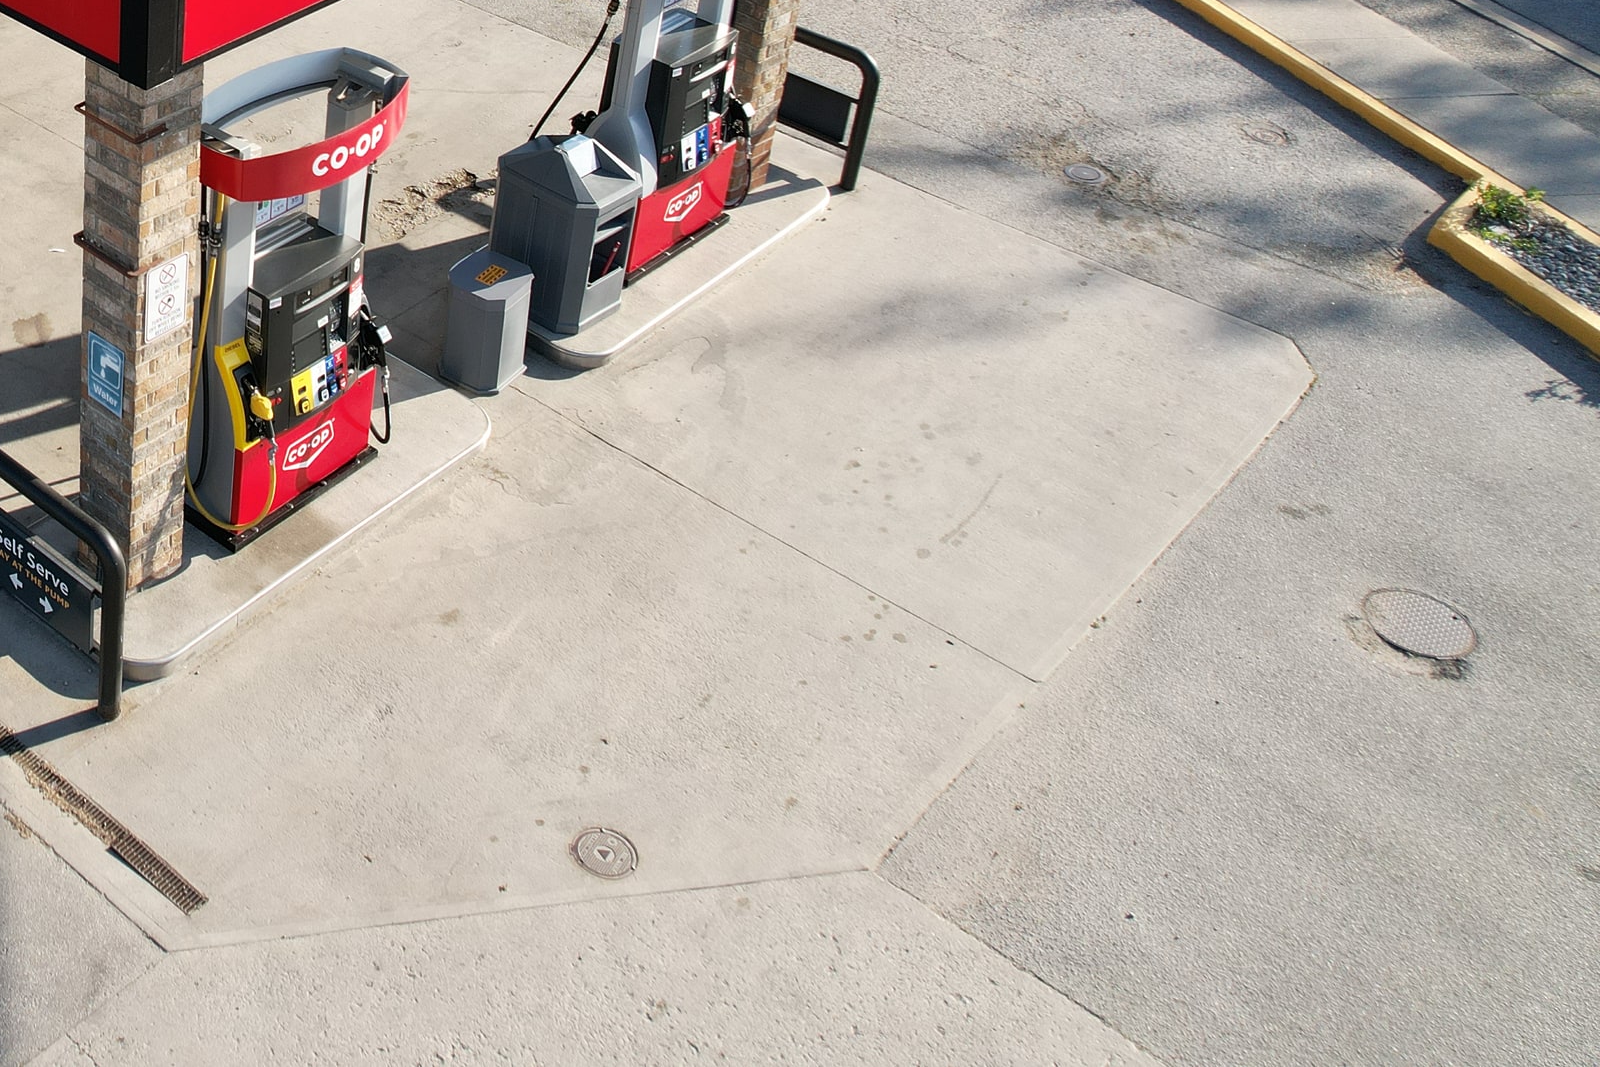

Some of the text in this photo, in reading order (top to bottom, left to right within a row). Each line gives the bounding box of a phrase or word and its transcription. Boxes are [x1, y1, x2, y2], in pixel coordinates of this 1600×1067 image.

[93, 383, 118, 407] Water
[12, 560, 24, 573] AT
[25, 569, 43, 589] THE
[45, 585, 70, 609] PUMP
[27, 552, 69, 596] Serve
